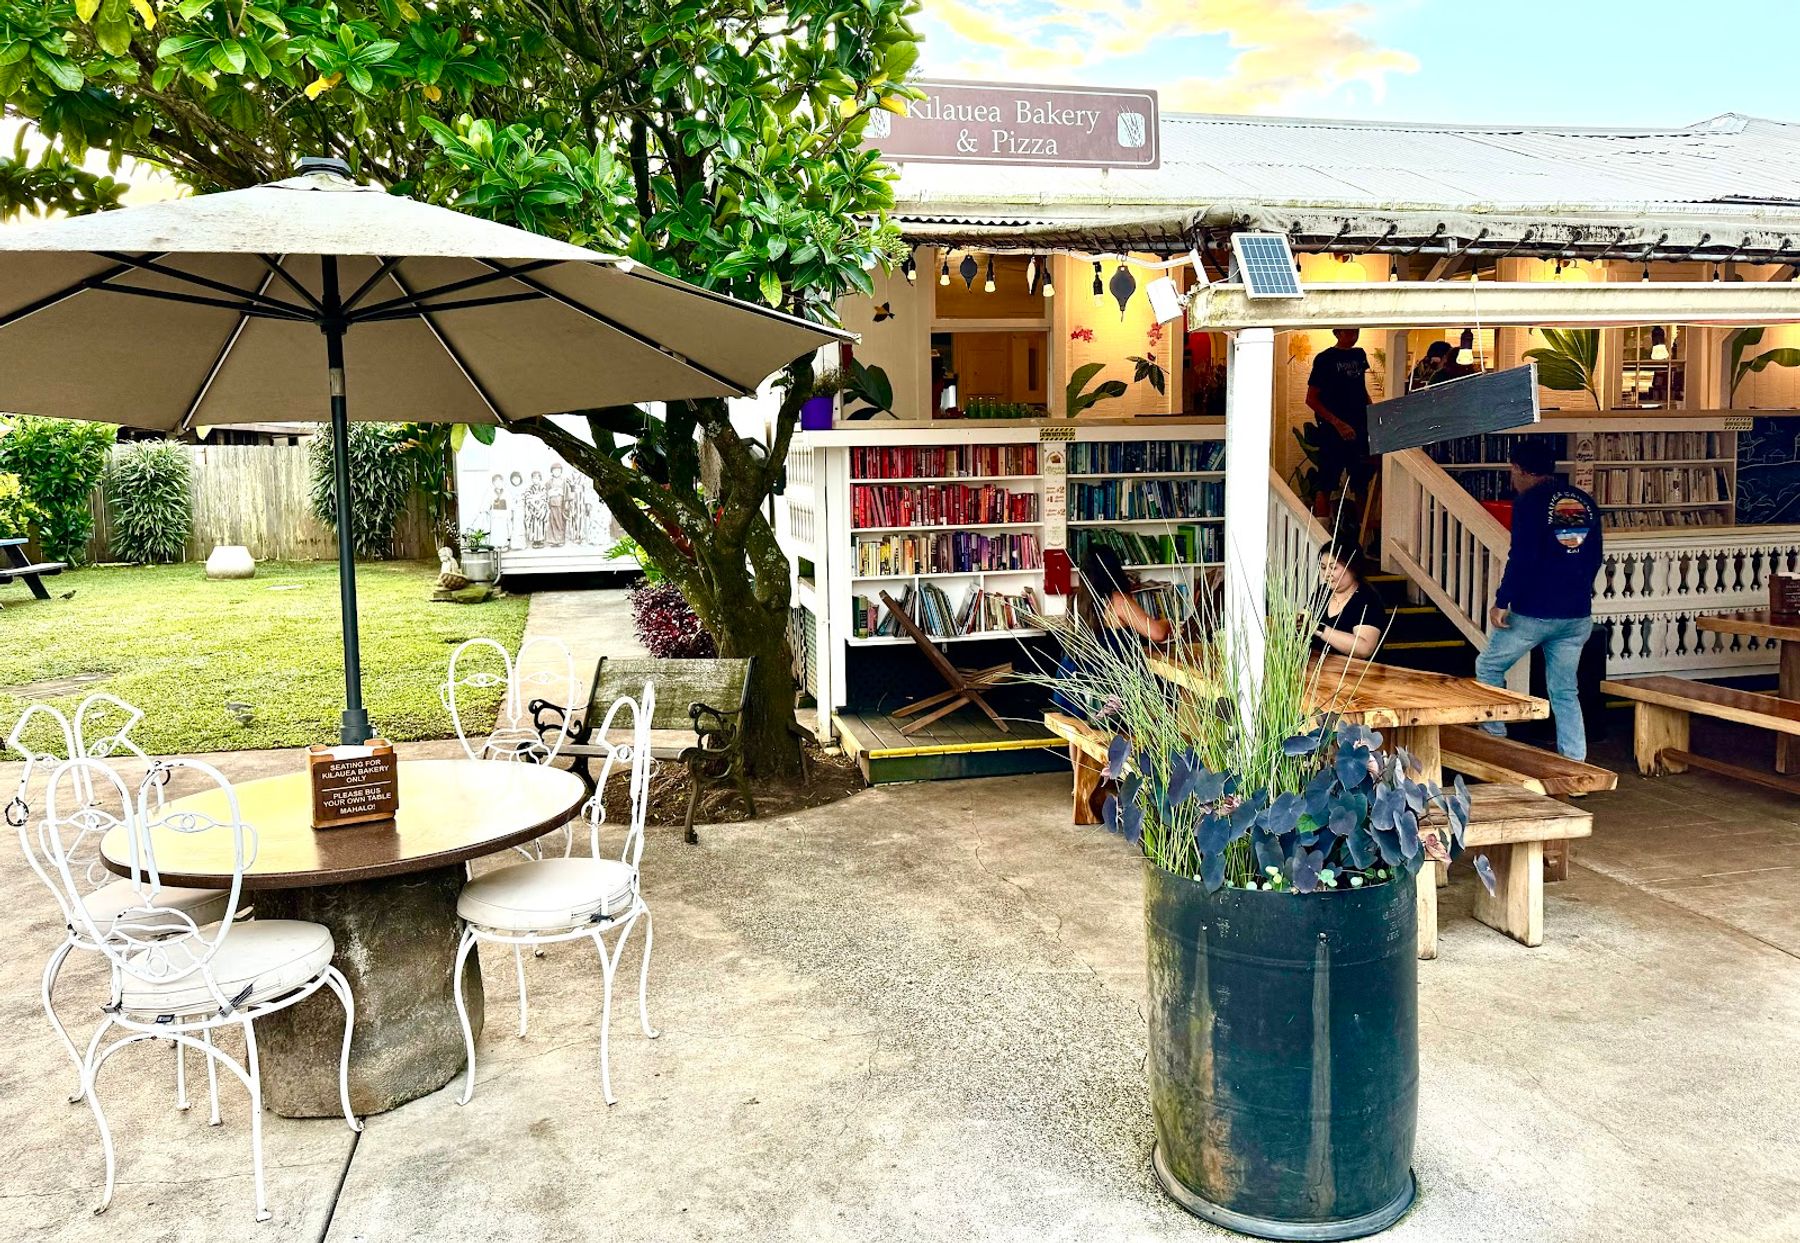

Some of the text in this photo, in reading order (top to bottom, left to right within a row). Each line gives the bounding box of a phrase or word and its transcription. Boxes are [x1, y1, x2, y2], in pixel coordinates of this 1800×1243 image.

[905, 97, 1101, 134] Kilauea Bakery
[956, 128, 1059, 155] & Pizza
[322, 765, 389, 779] KILAUEA BAKERY
[330, 761, 363, 771] SEATING
[346, 775, 366, 783] ONLY
[323, 799, 345, 807] YOUR
[368, 792, 391, 801] TABLE
[333, 790, 363, 799] PLEASE
[340, 804, 375, 814] MAHALO!
